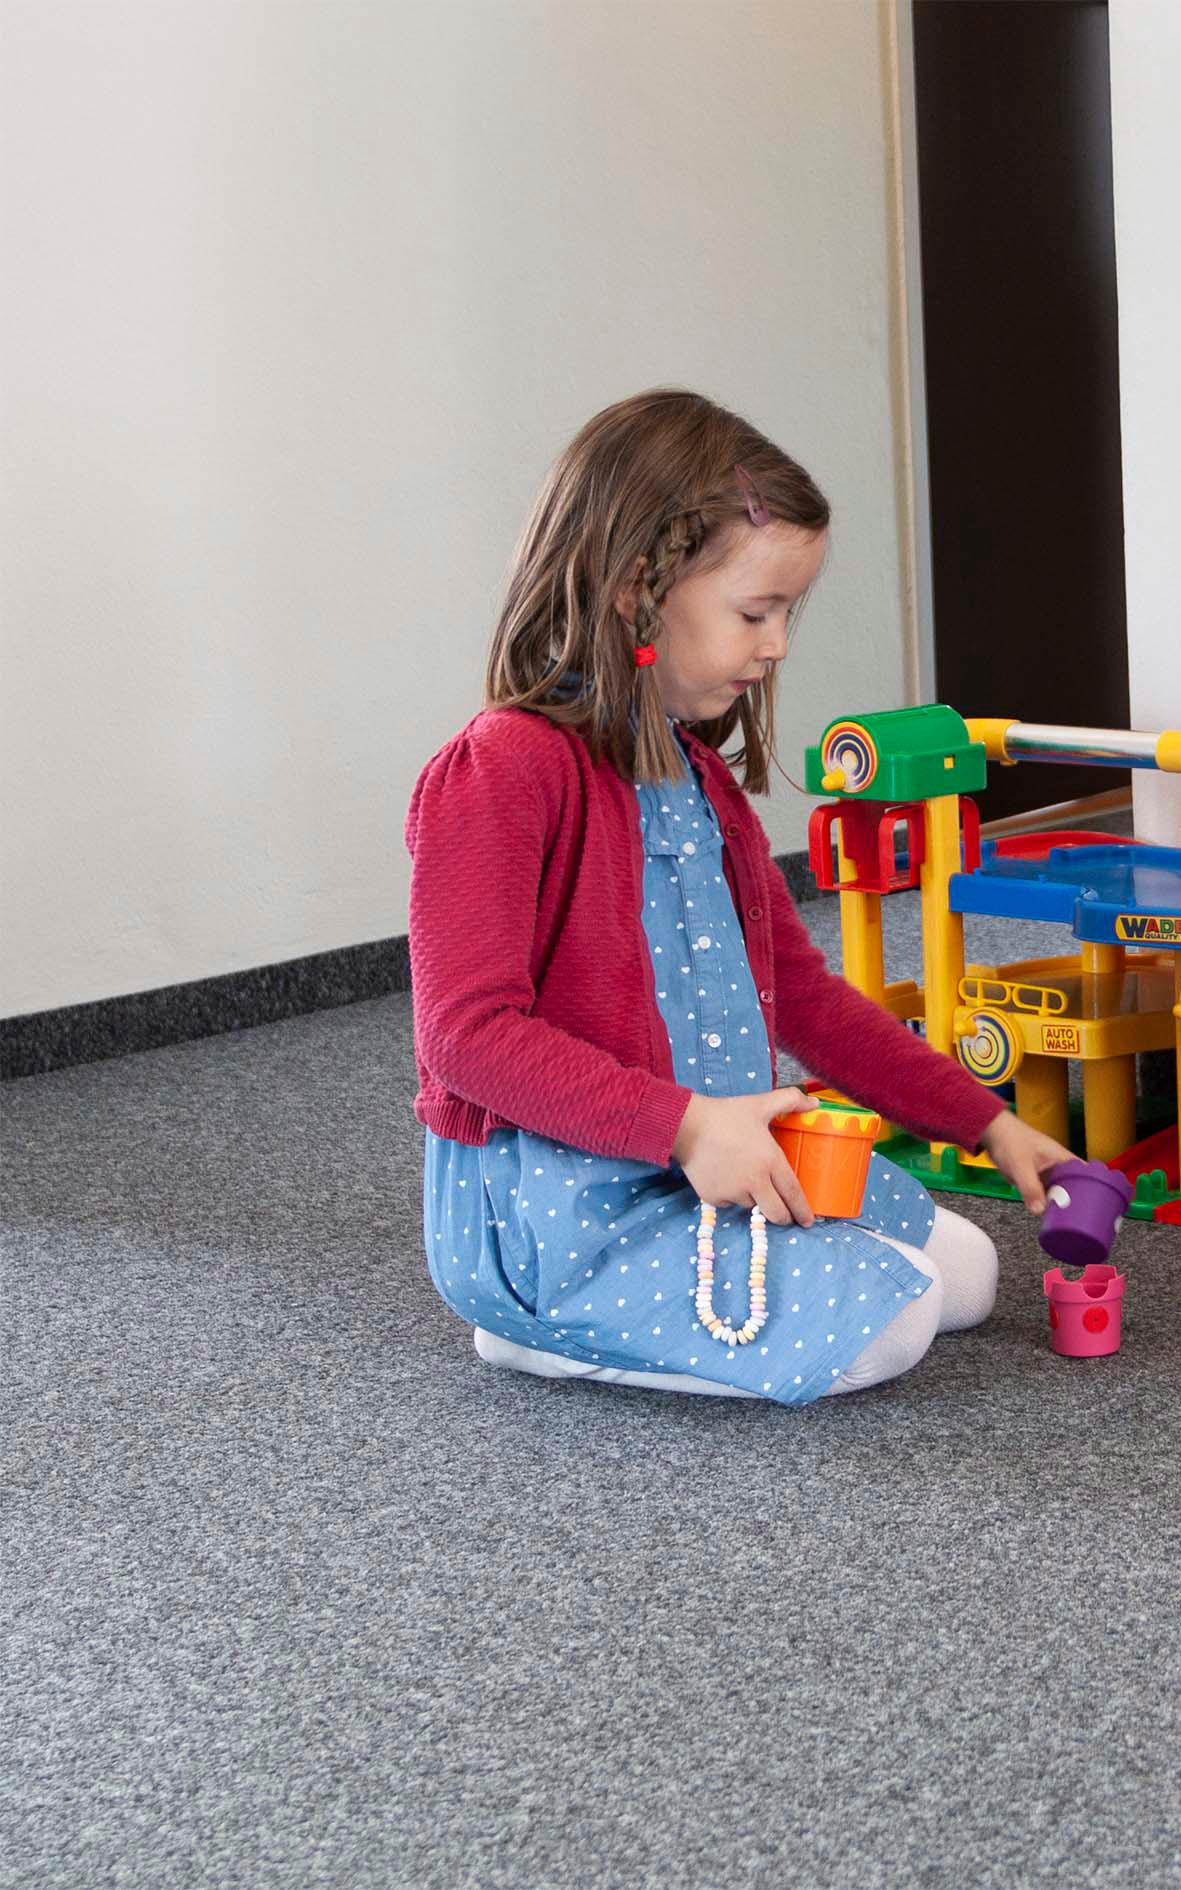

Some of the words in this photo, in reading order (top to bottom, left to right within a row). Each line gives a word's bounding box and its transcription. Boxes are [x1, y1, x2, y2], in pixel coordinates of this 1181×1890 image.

[1145, 932, 1177, 941] QUALITY
[1046, 1029, 1073, 1039] AUTO
[1045, 1039, 1075, 1050] WASH
